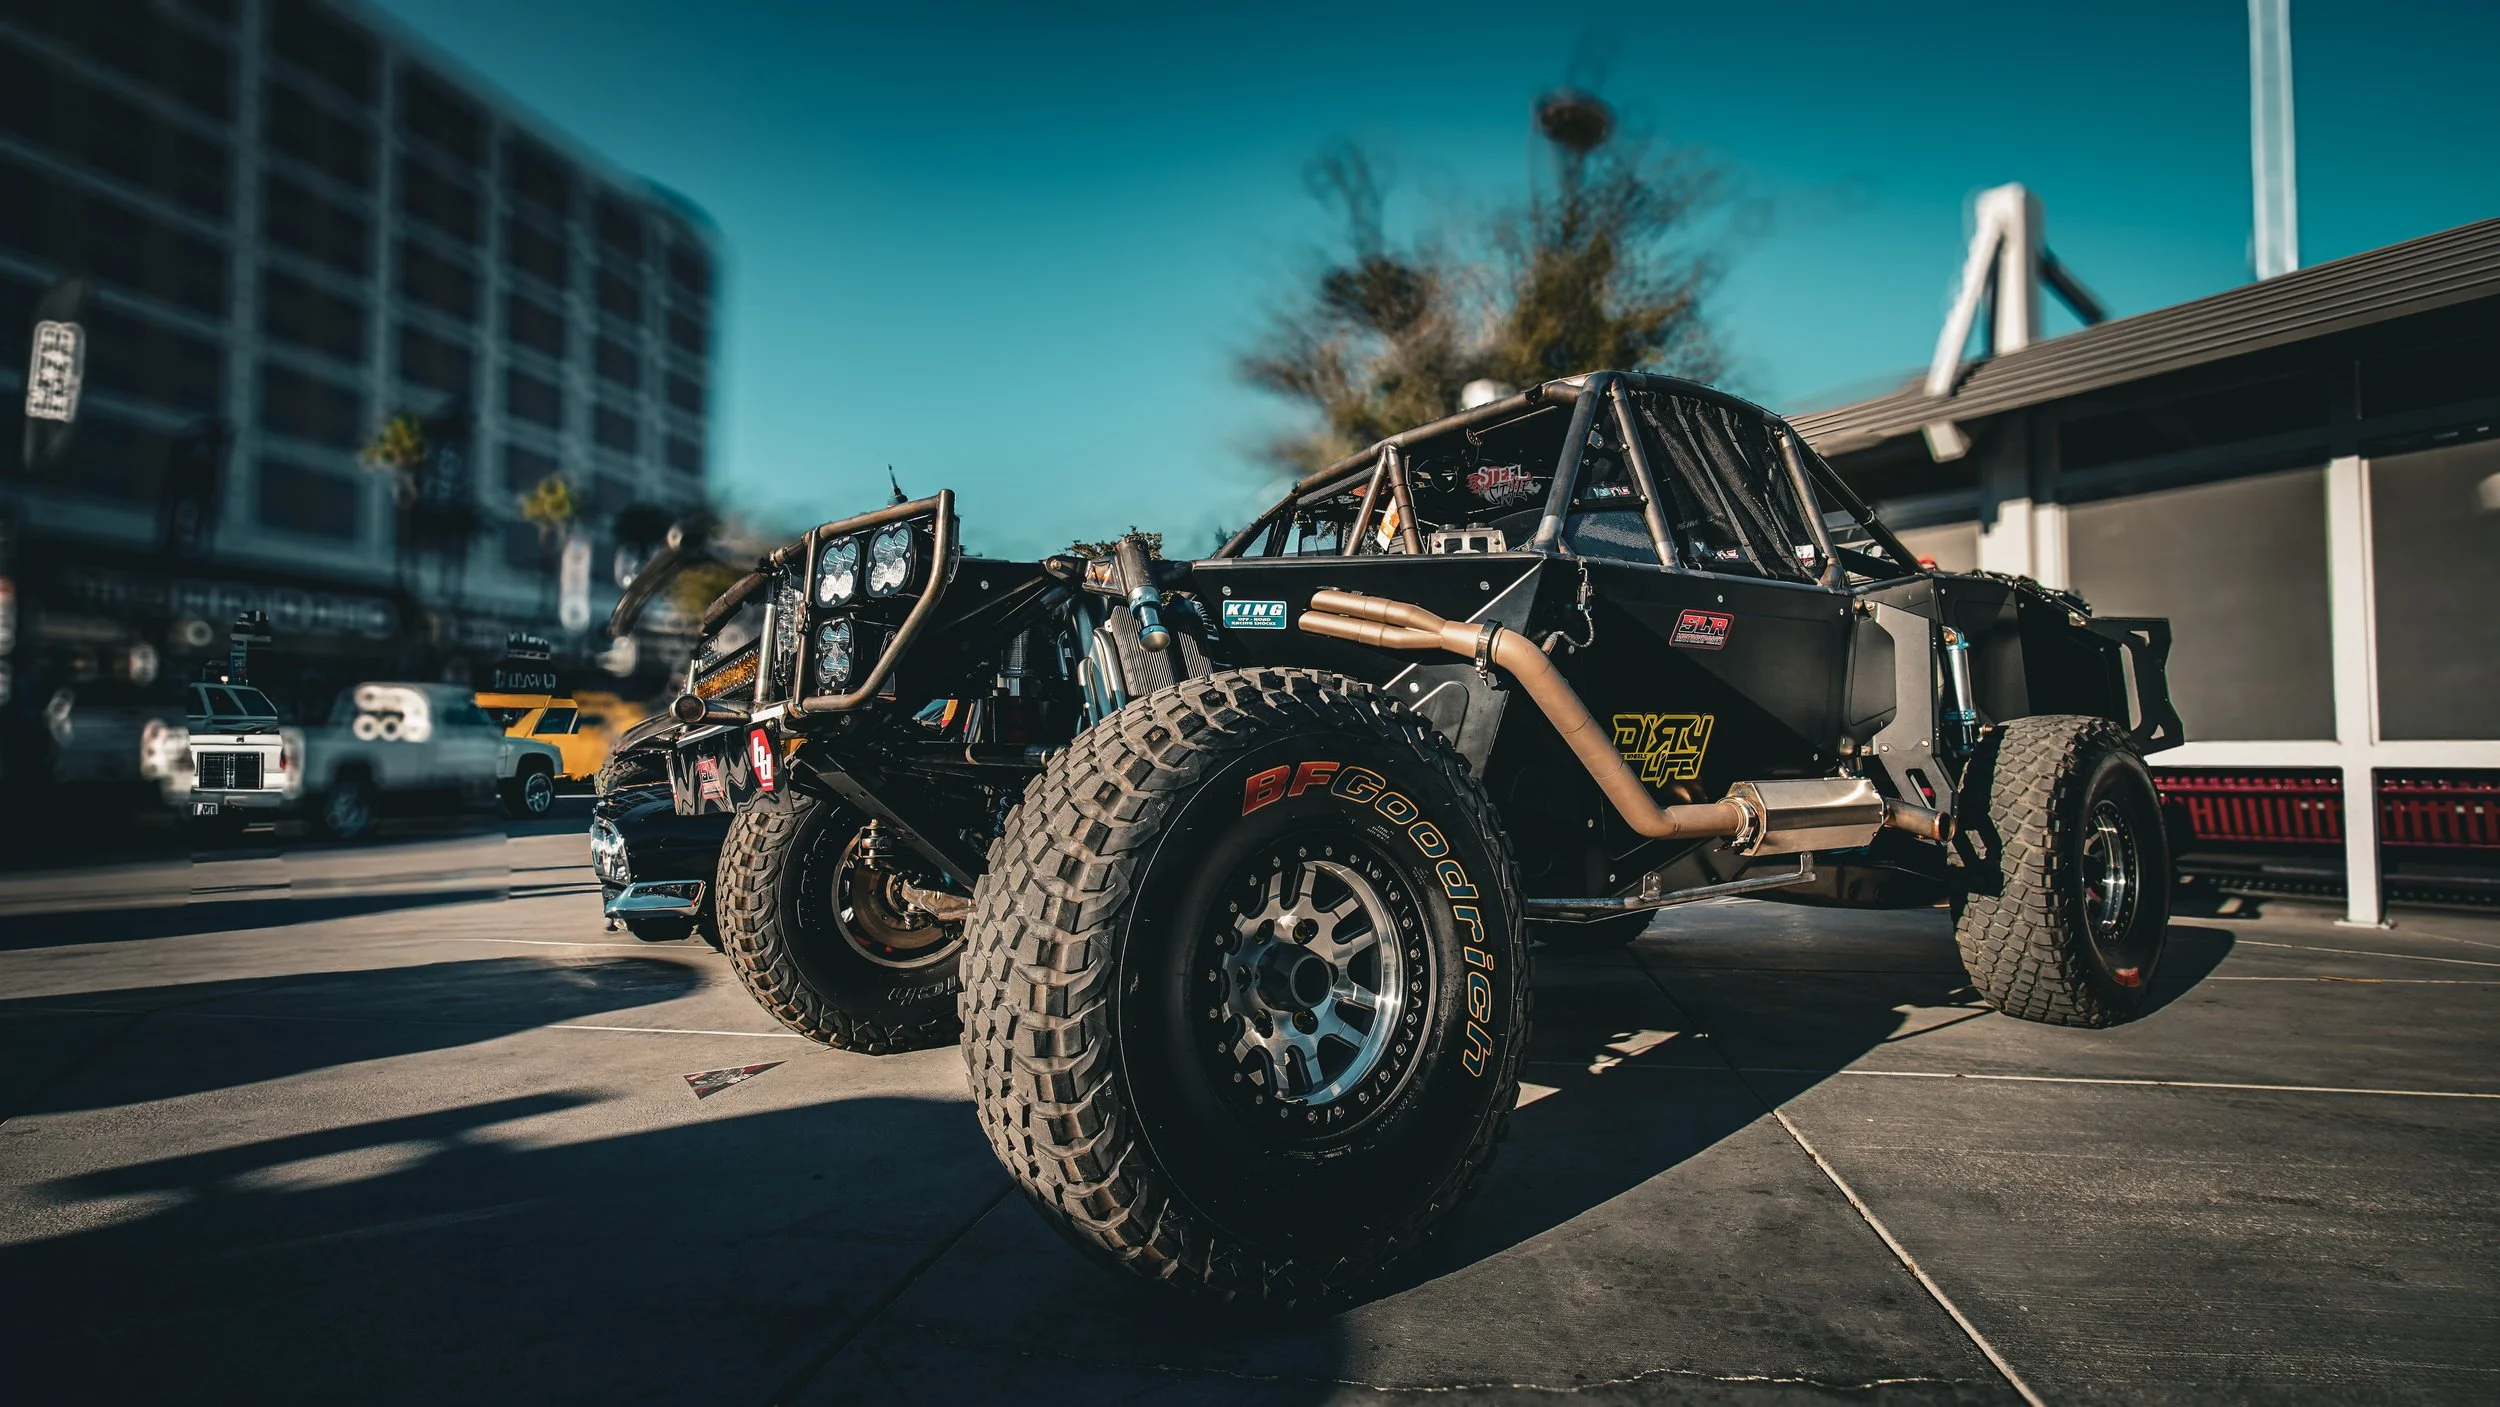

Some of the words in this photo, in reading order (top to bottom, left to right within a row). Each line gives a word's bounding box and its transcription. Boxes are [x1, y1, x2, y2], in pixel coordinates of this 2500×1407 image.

[1477, 464, 1531, 487] STEEL
[1226, 603, 1283, 616] KING
[1679, 615, 1729, 636] SLR
[1242, 761, 1494, 1077] BFGoodrich
